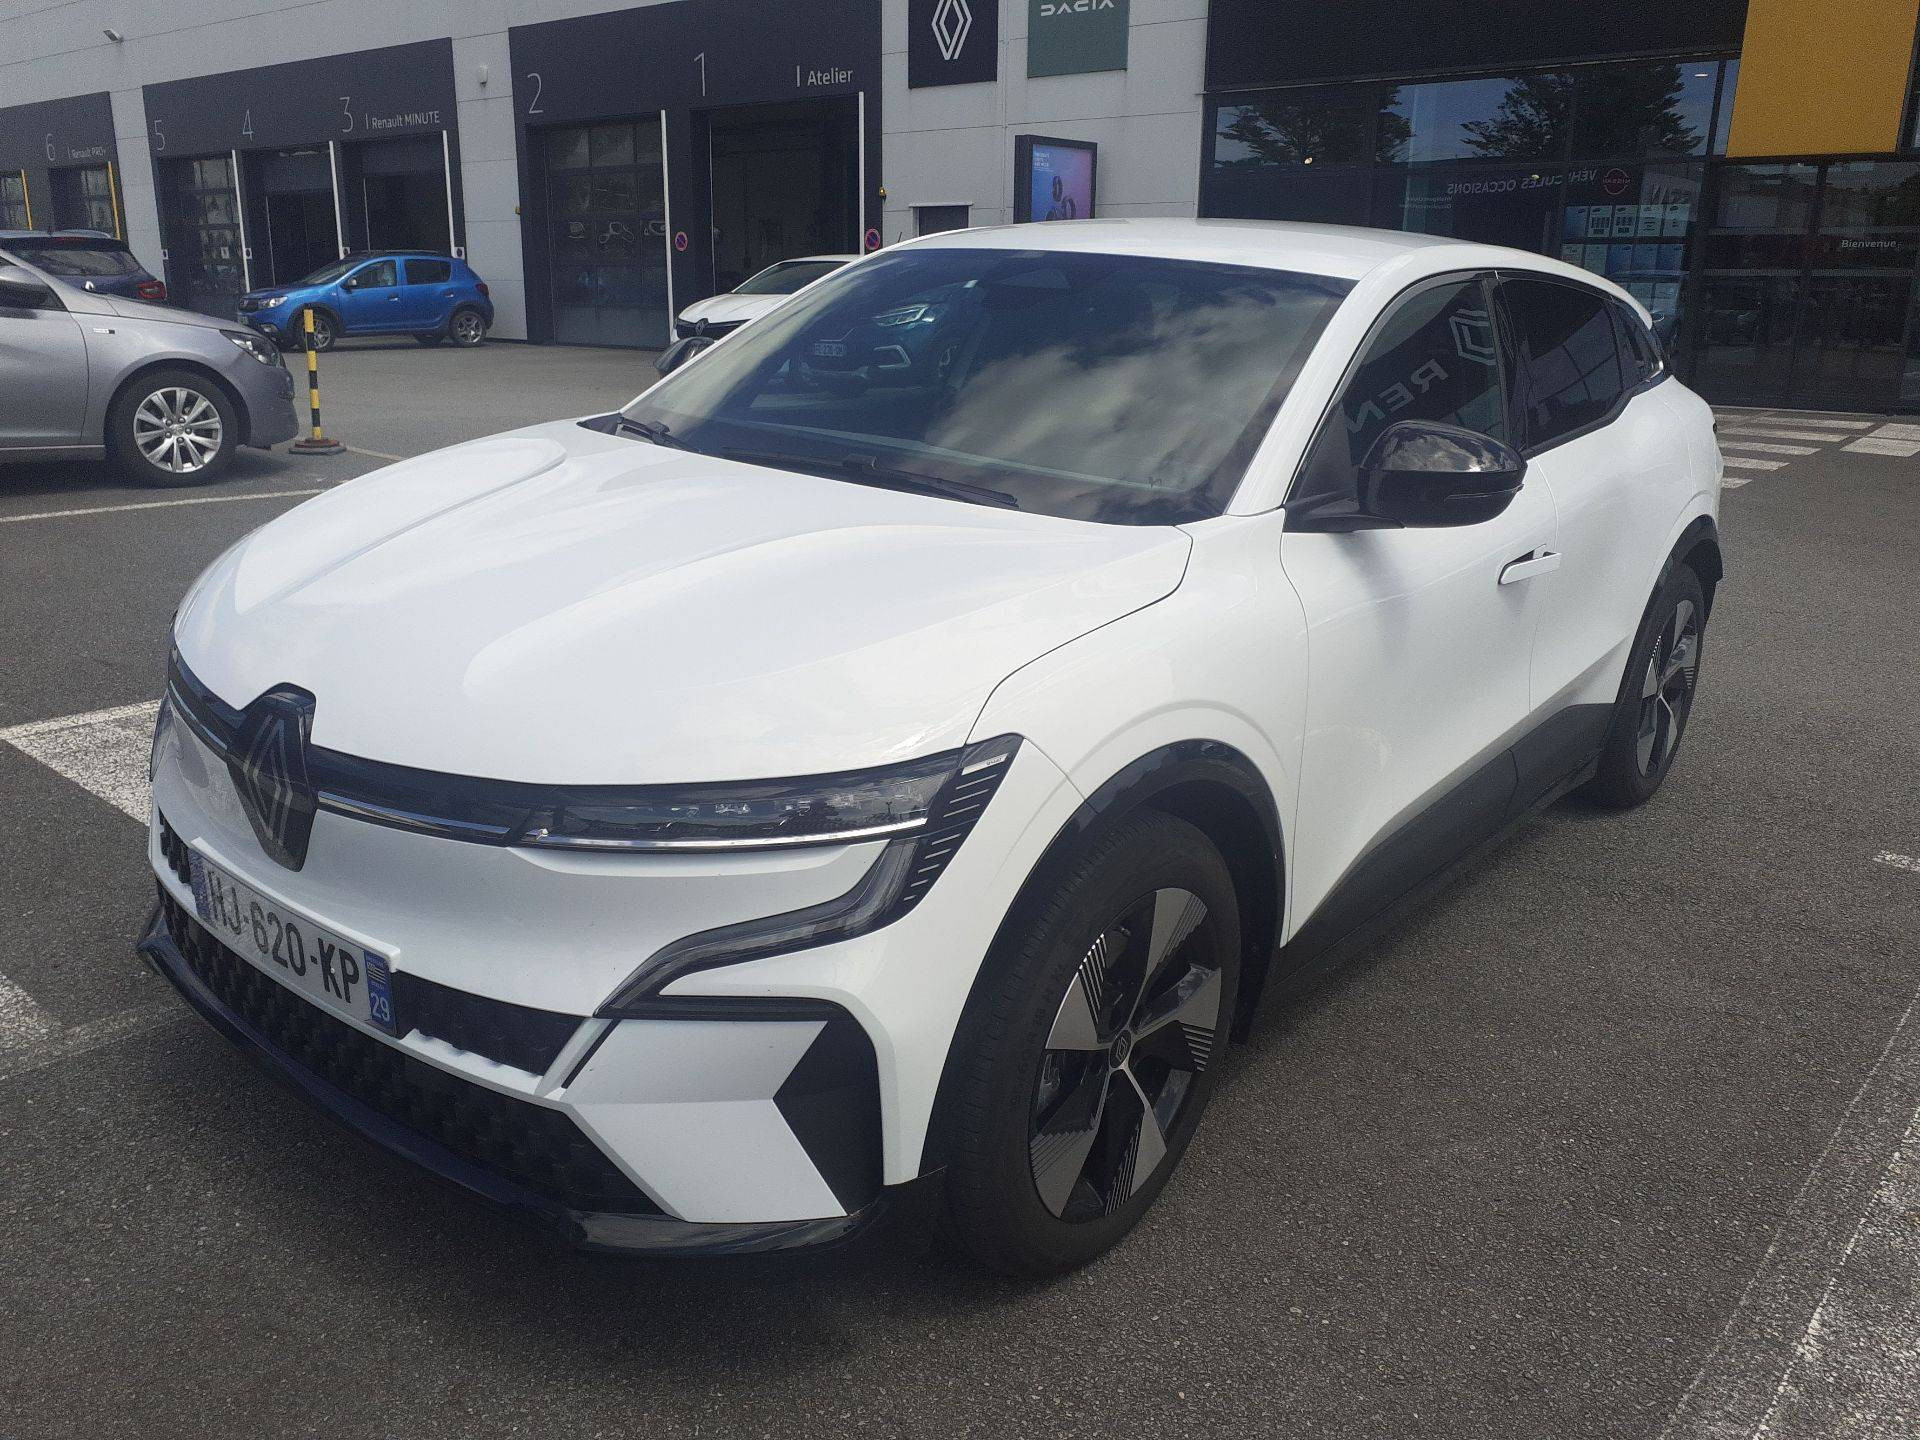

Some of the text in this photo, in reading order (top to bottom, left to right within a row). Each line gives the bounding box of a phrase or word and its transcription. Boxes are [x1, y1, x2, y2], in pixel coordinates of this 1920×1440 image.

[1041, 0, 1115, 17] DACIA
[694, 52, 705, 96] 1
[807, 67, 853, 86] Atelier
[527, 73, 544, 113] 2
[243, 109, 254, 142] 4
[340, 97, 353, 132] 3
[371, 110, 440, 129] Renault MINUTE
[46, 133, 56, 161] 6
[154, 120, 165, 151] 5
[1841, 239, 1897, 248] Bienvenue
[207, 870, 359, 1004] HJ-620-KP
[370, 993, 391, 1022] 29
